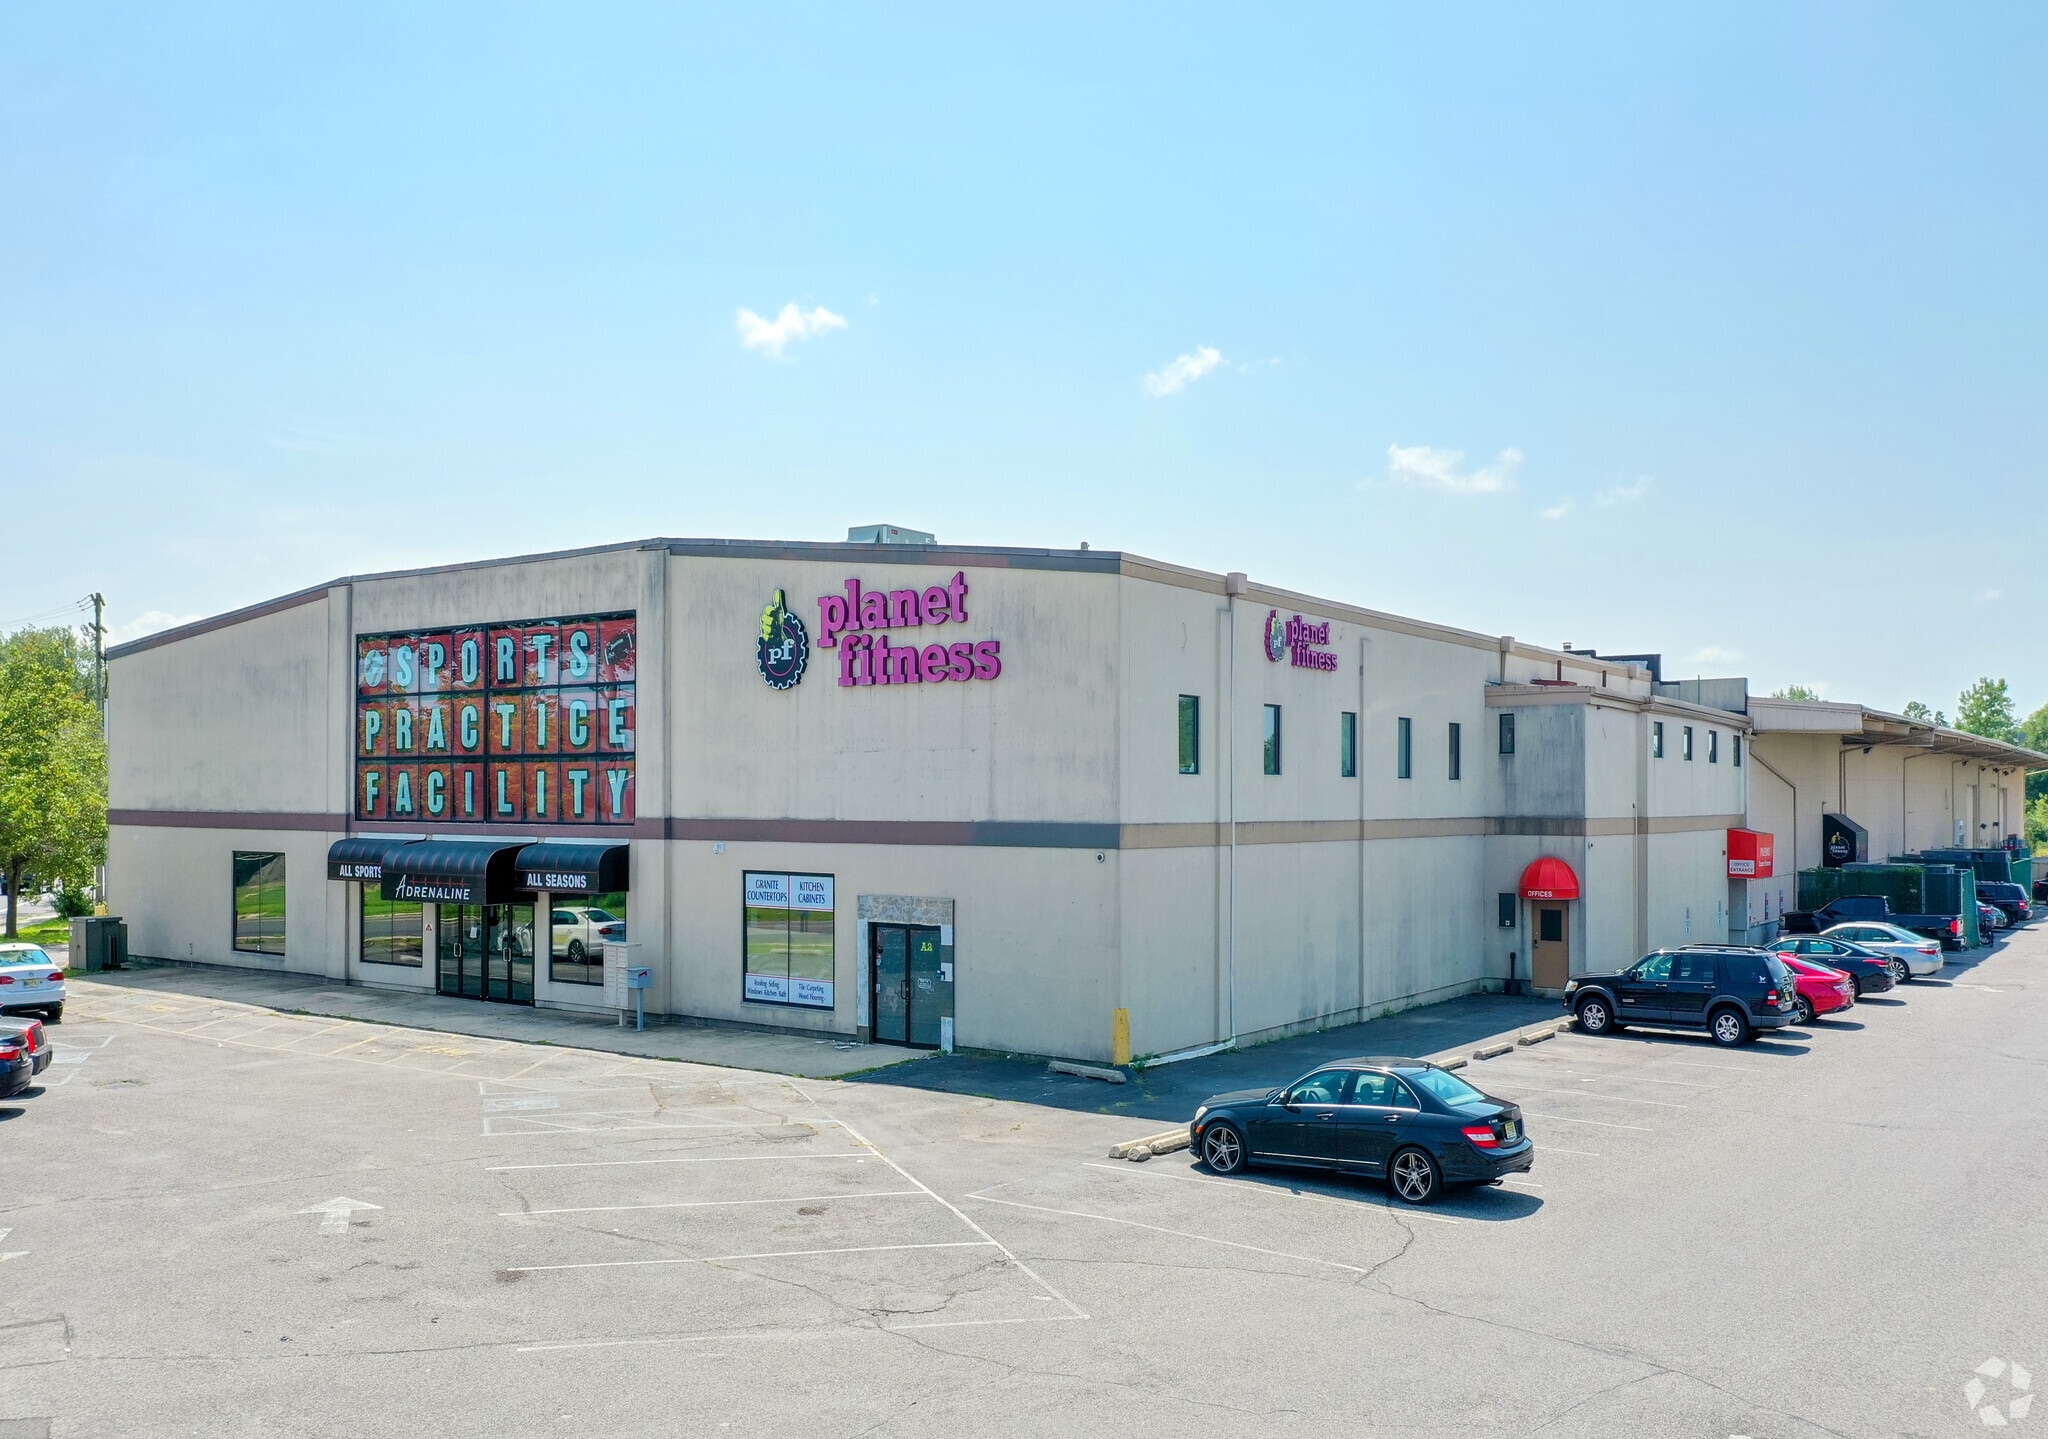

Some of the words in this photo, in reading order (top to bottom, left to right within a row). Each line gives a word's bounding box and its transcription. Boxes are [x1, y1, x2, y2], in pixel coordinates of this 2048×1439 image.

[817, 571, 968, 647] planet
[1286, 615, 1330, 647] planet
[396, 630, 590, 687] SPORTS
[768, 639, 795, 665] pf
[838, 634, 1002, 687] fitness
[1291, 640, 1338, 671] fitness
[365, 698, 627, 750] PRACTICE
[365, 769, 626, 815] FACILITY
[339, 864, 353, 877] ALL
[355, 865, 382, 878] SPORTS
[526, 873, 543, 886] ALL
[545, 873, 587, 888] SEASONS
[755, 879, 779, 890] GRANITE
[799, 881, 825, 892] KITCHEN
[1527, 890, 1553, 898] OFFICES
[747, 890, 788, 903] COUNTERTOPS
[798, 893, 826, 905] CABINETS
[920, 942, 933, 952] A2
